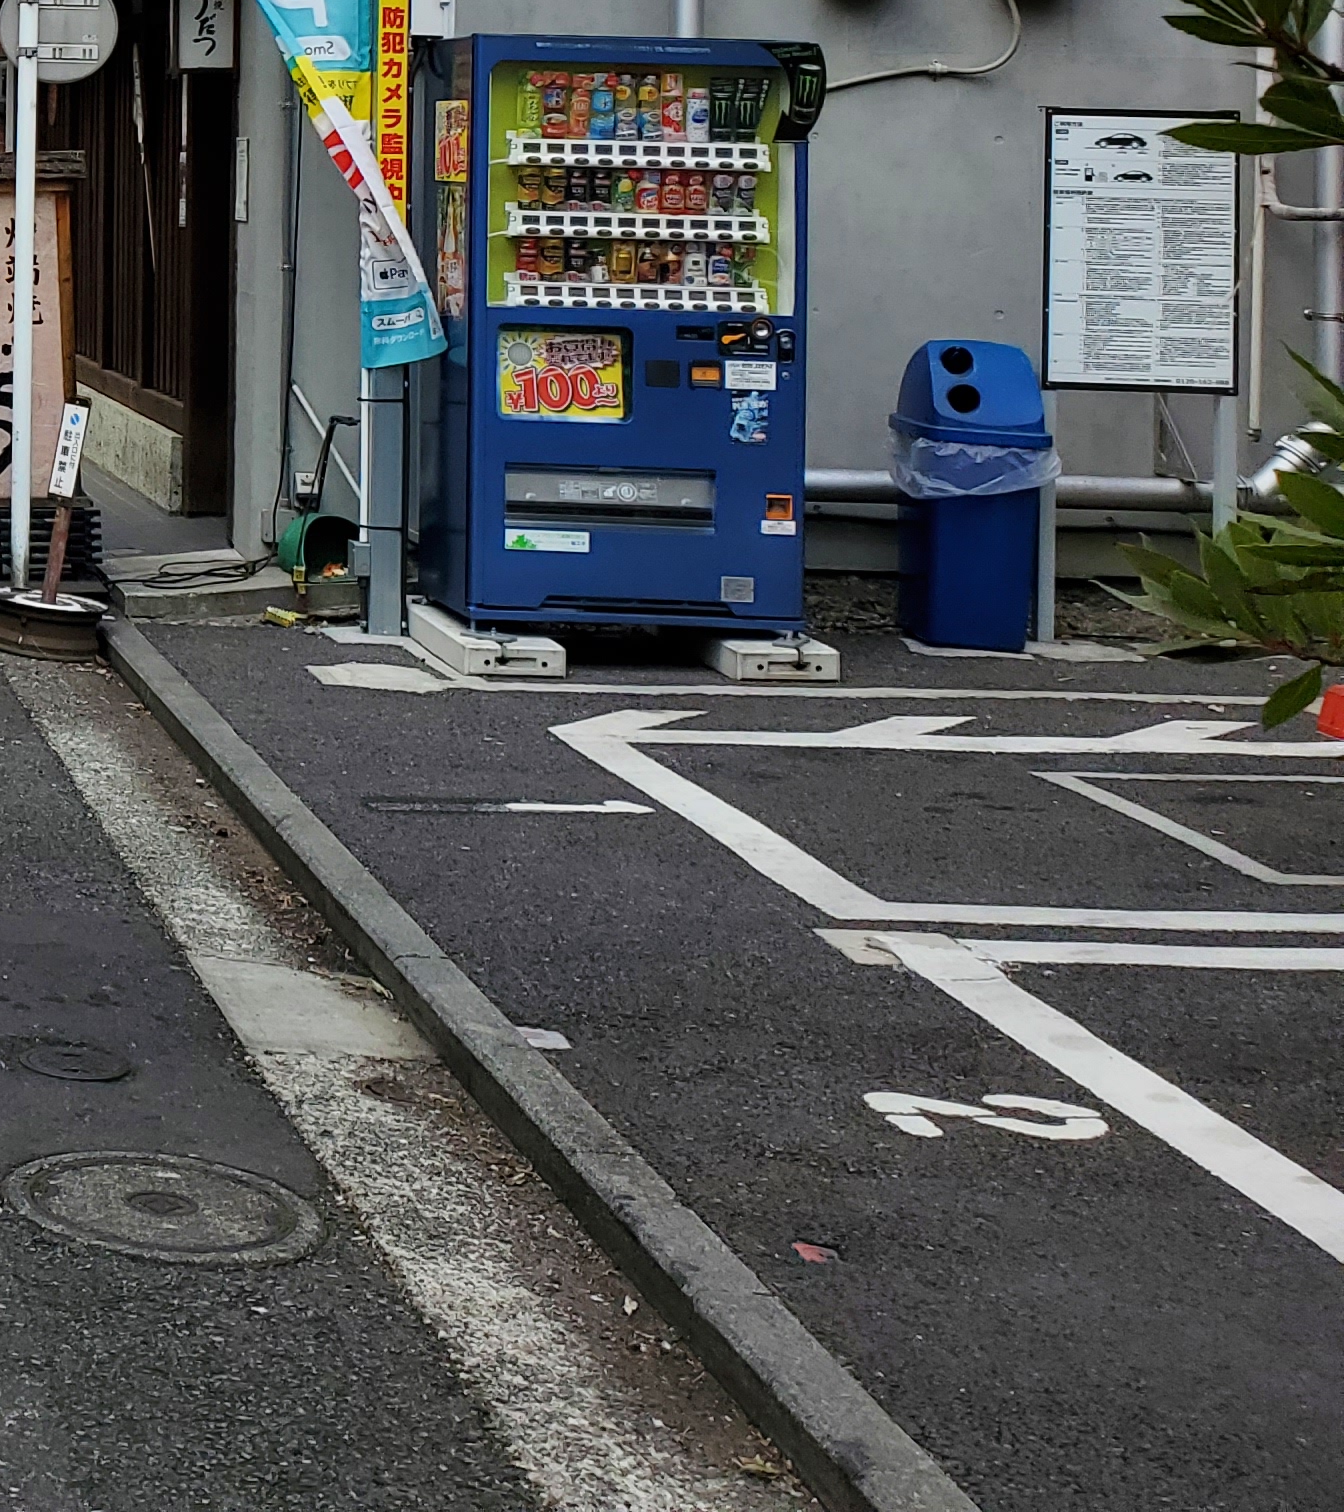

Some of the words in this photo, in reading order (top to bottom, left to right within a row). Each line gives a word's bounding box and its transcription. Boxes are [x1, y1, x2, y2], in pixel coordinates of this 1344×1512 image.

[379, 5, 406, 202] 防犯カメラ監視中
[505, 365, 603, 413] ¥100
[54, 429, 73, 489] 駐車禁止
